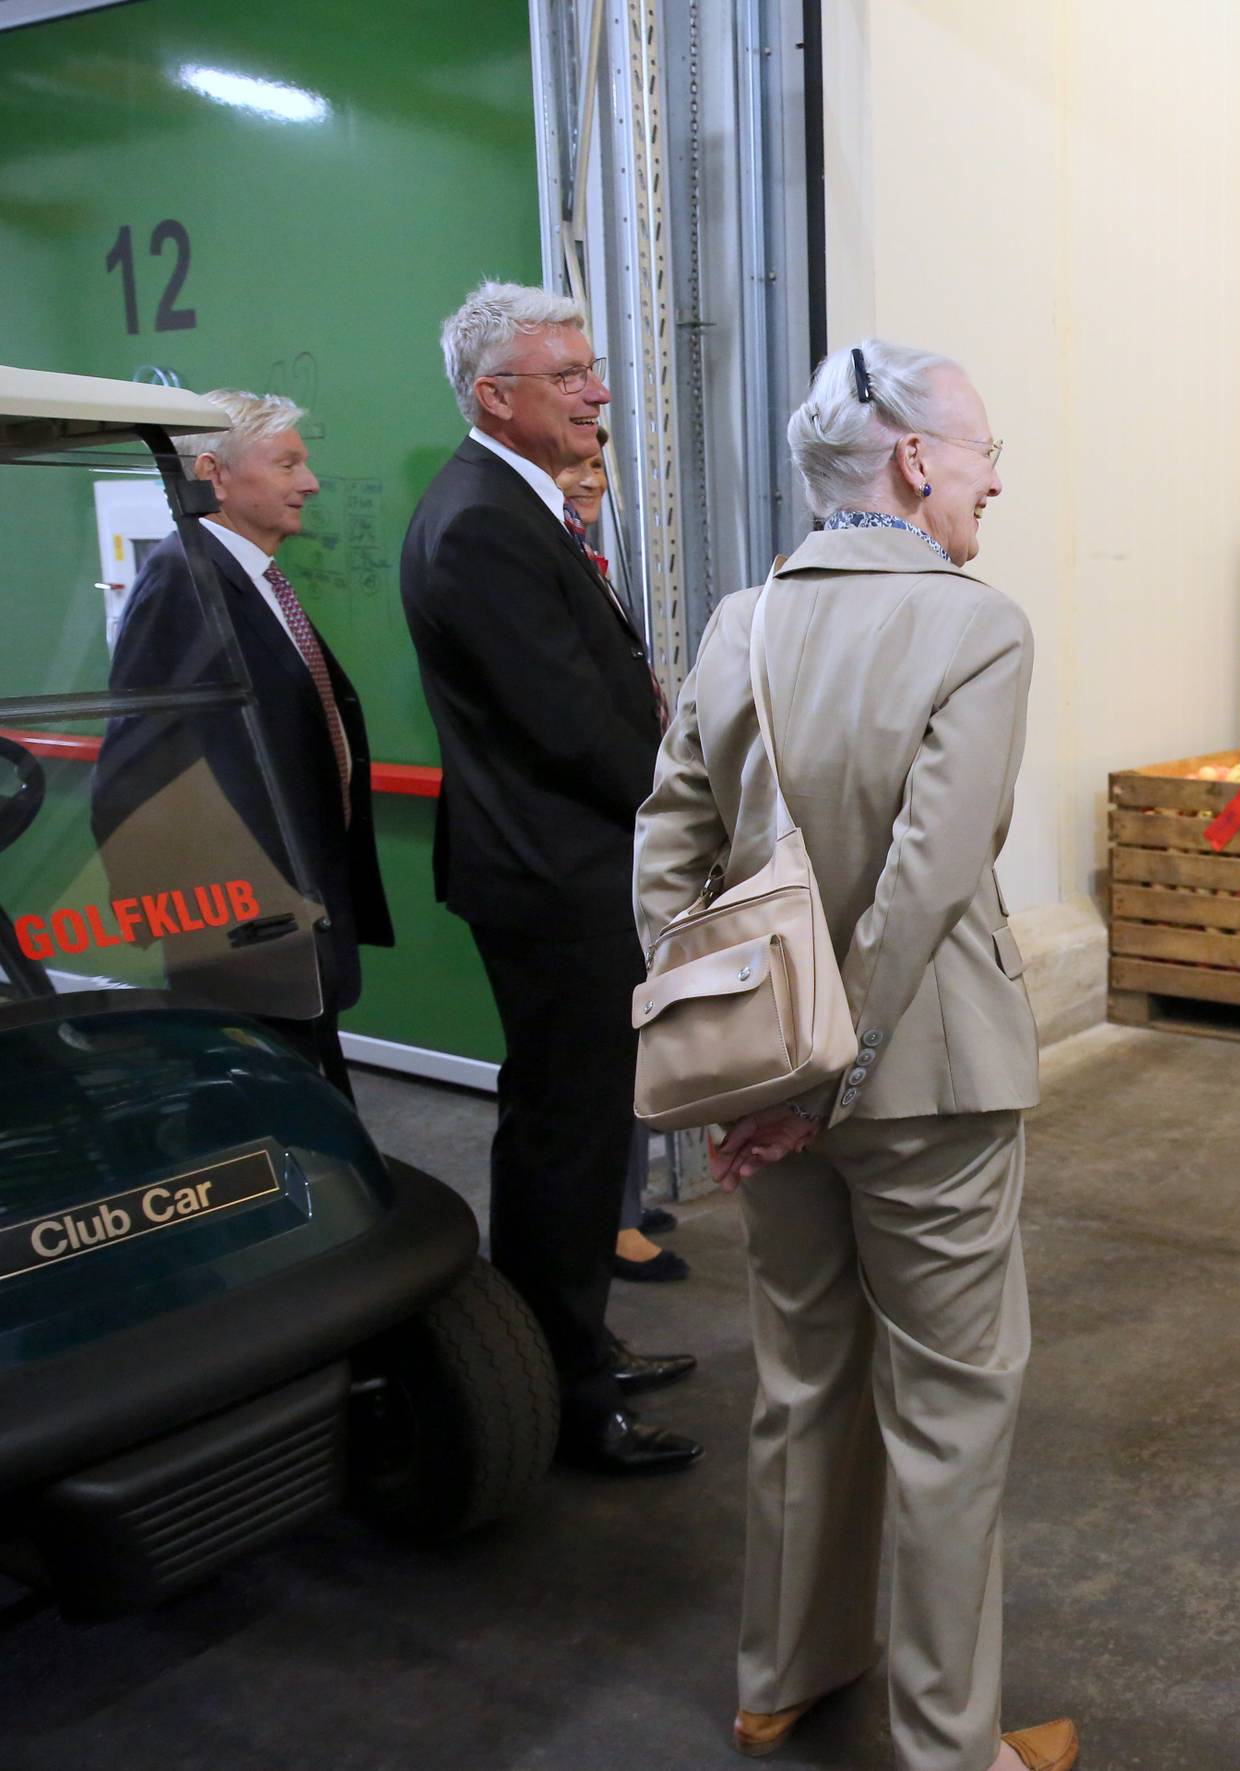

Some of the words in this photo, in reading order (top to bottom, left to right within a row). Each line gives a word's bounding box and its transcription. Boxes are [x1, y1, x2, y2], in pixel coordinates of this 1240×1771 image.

[105, 219, 197, 335] 12
[14, 879, 261, 961] GOLFKLUB
[30, 1204, 132, 1258] Club
[141, 1180, 213, 1223] Car
